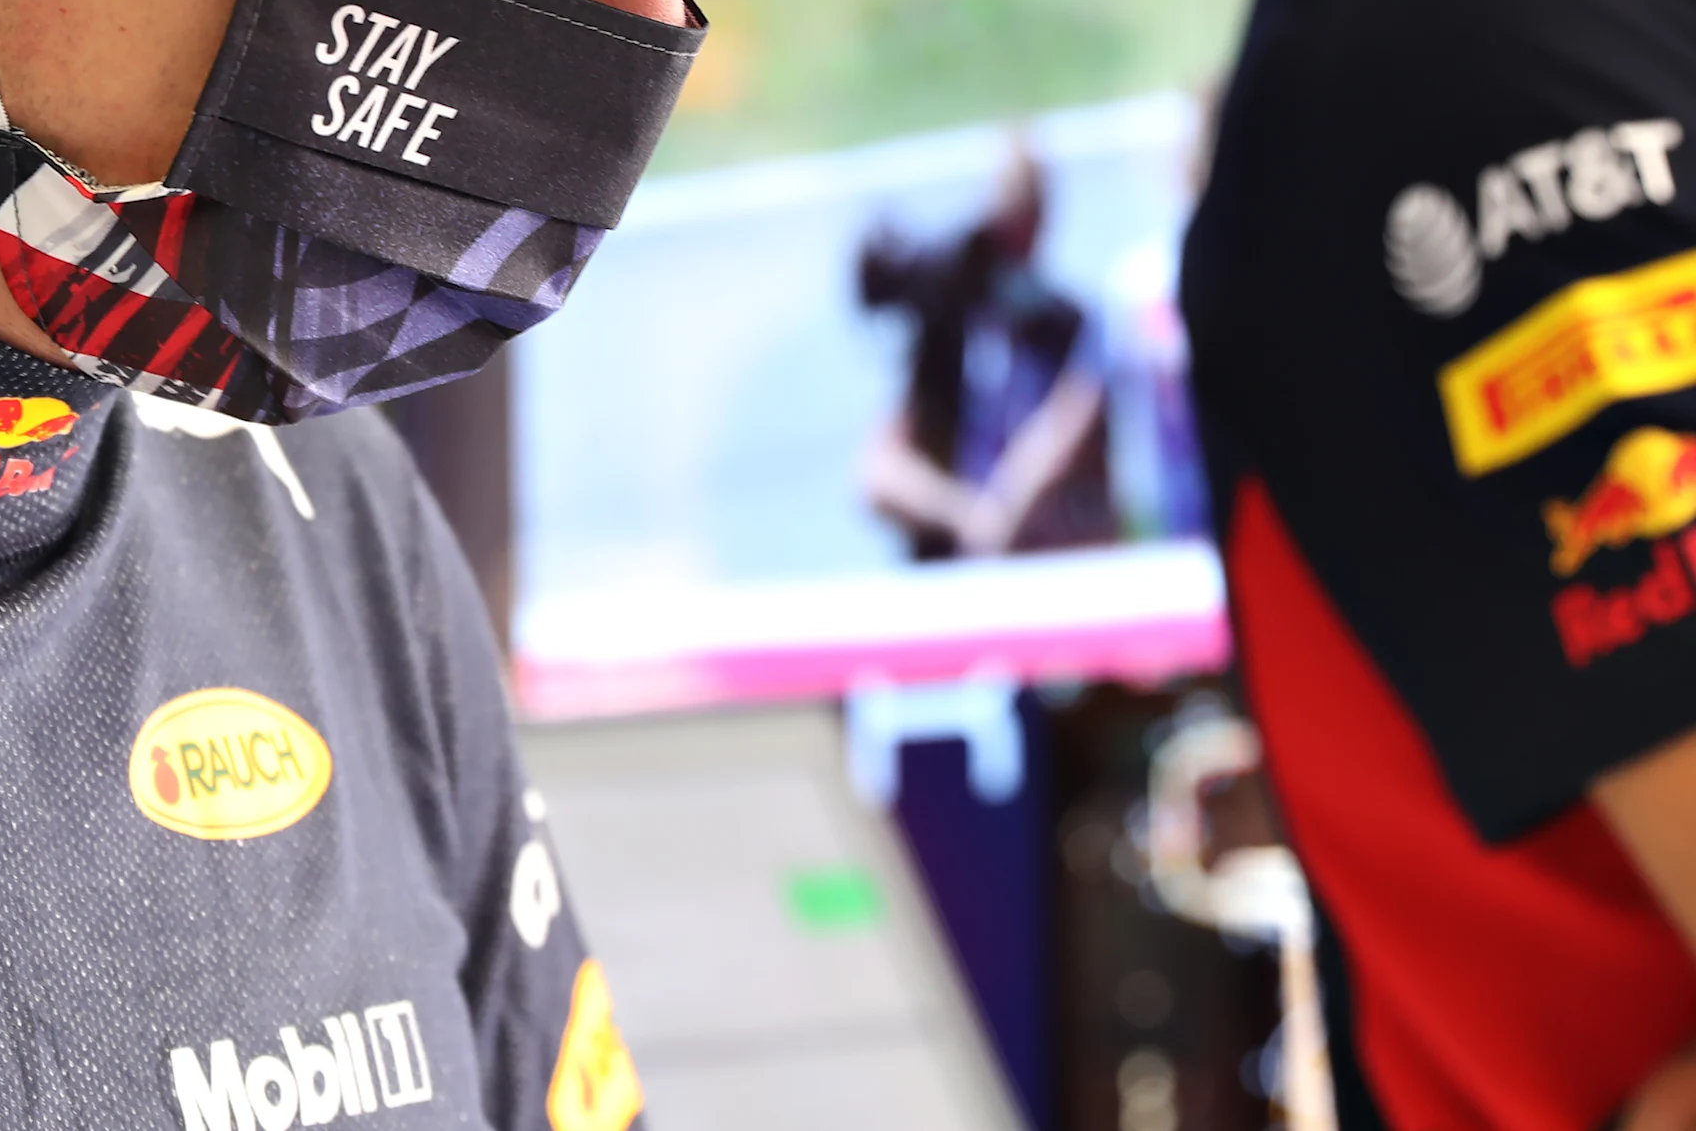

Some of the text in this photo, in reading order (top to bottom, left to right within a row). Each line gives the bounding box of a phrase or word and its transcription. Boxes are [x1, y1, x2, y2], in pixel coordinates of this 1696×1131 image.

[315, 4, 459, 91] STAY
[311, 83, 457, 166] SAFE
[1478, 118, 1683, 260] AT&T
[179, 728, 303, 799] RAUCH
